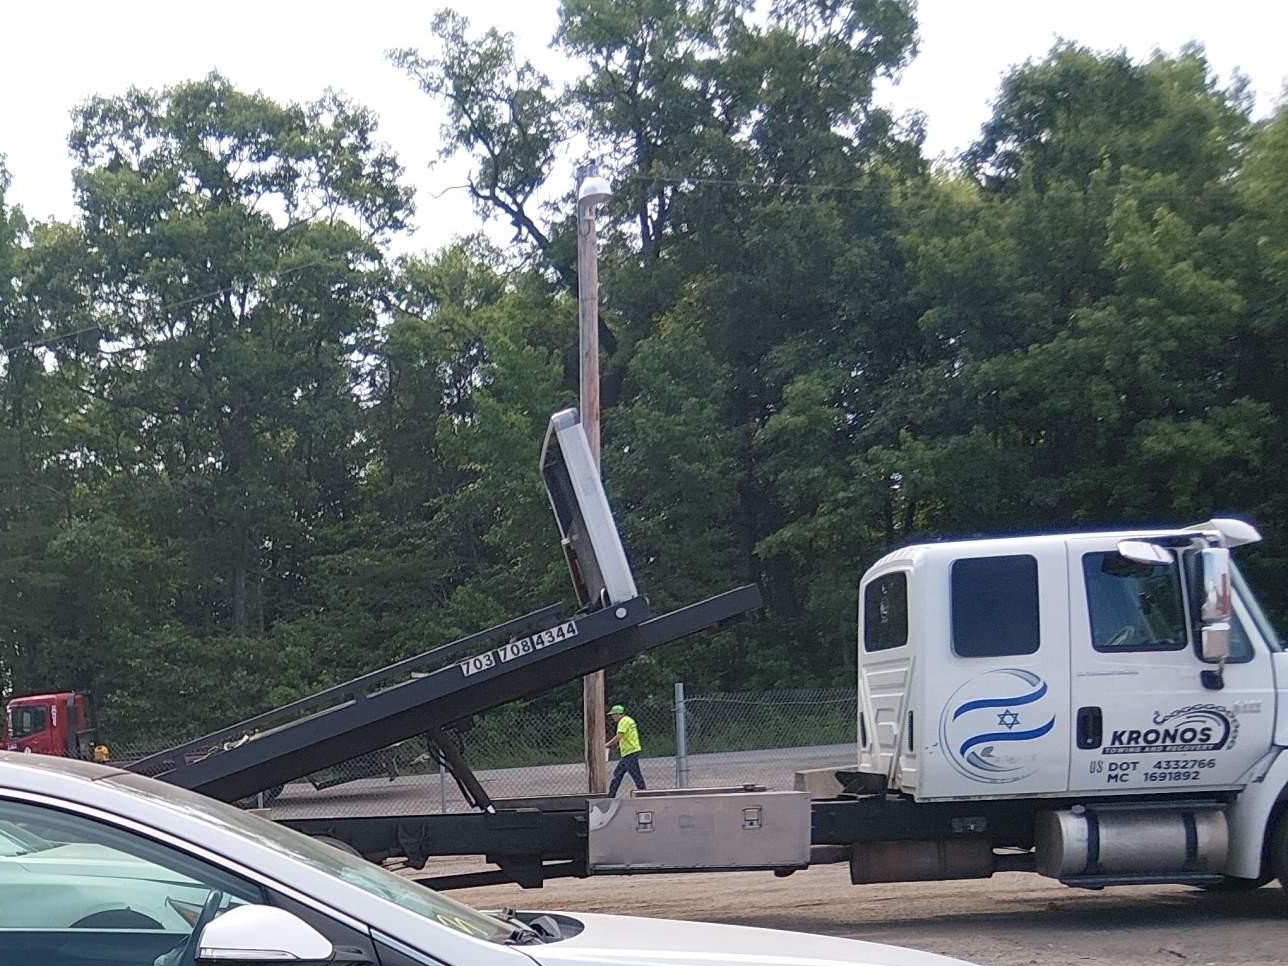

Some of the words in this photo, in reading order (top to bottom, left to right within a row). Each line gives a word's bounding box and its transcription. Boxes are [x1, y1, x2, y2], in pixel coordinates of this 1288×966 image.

[462, 653, 495, 675] 703
[500, 639, 532, 662] 708
[535, 621, 577, 649] 4344
[1109, 726, 1213, 746] KRONOS
[1089, 760, 1104, 774] US
[1108, 761, 1140, 772] DOT
[1152, 758, 1217, 771] 4332766
[1106, 772, 1130, 784] MC
[1142, 770, 1201, 783] 1691892
